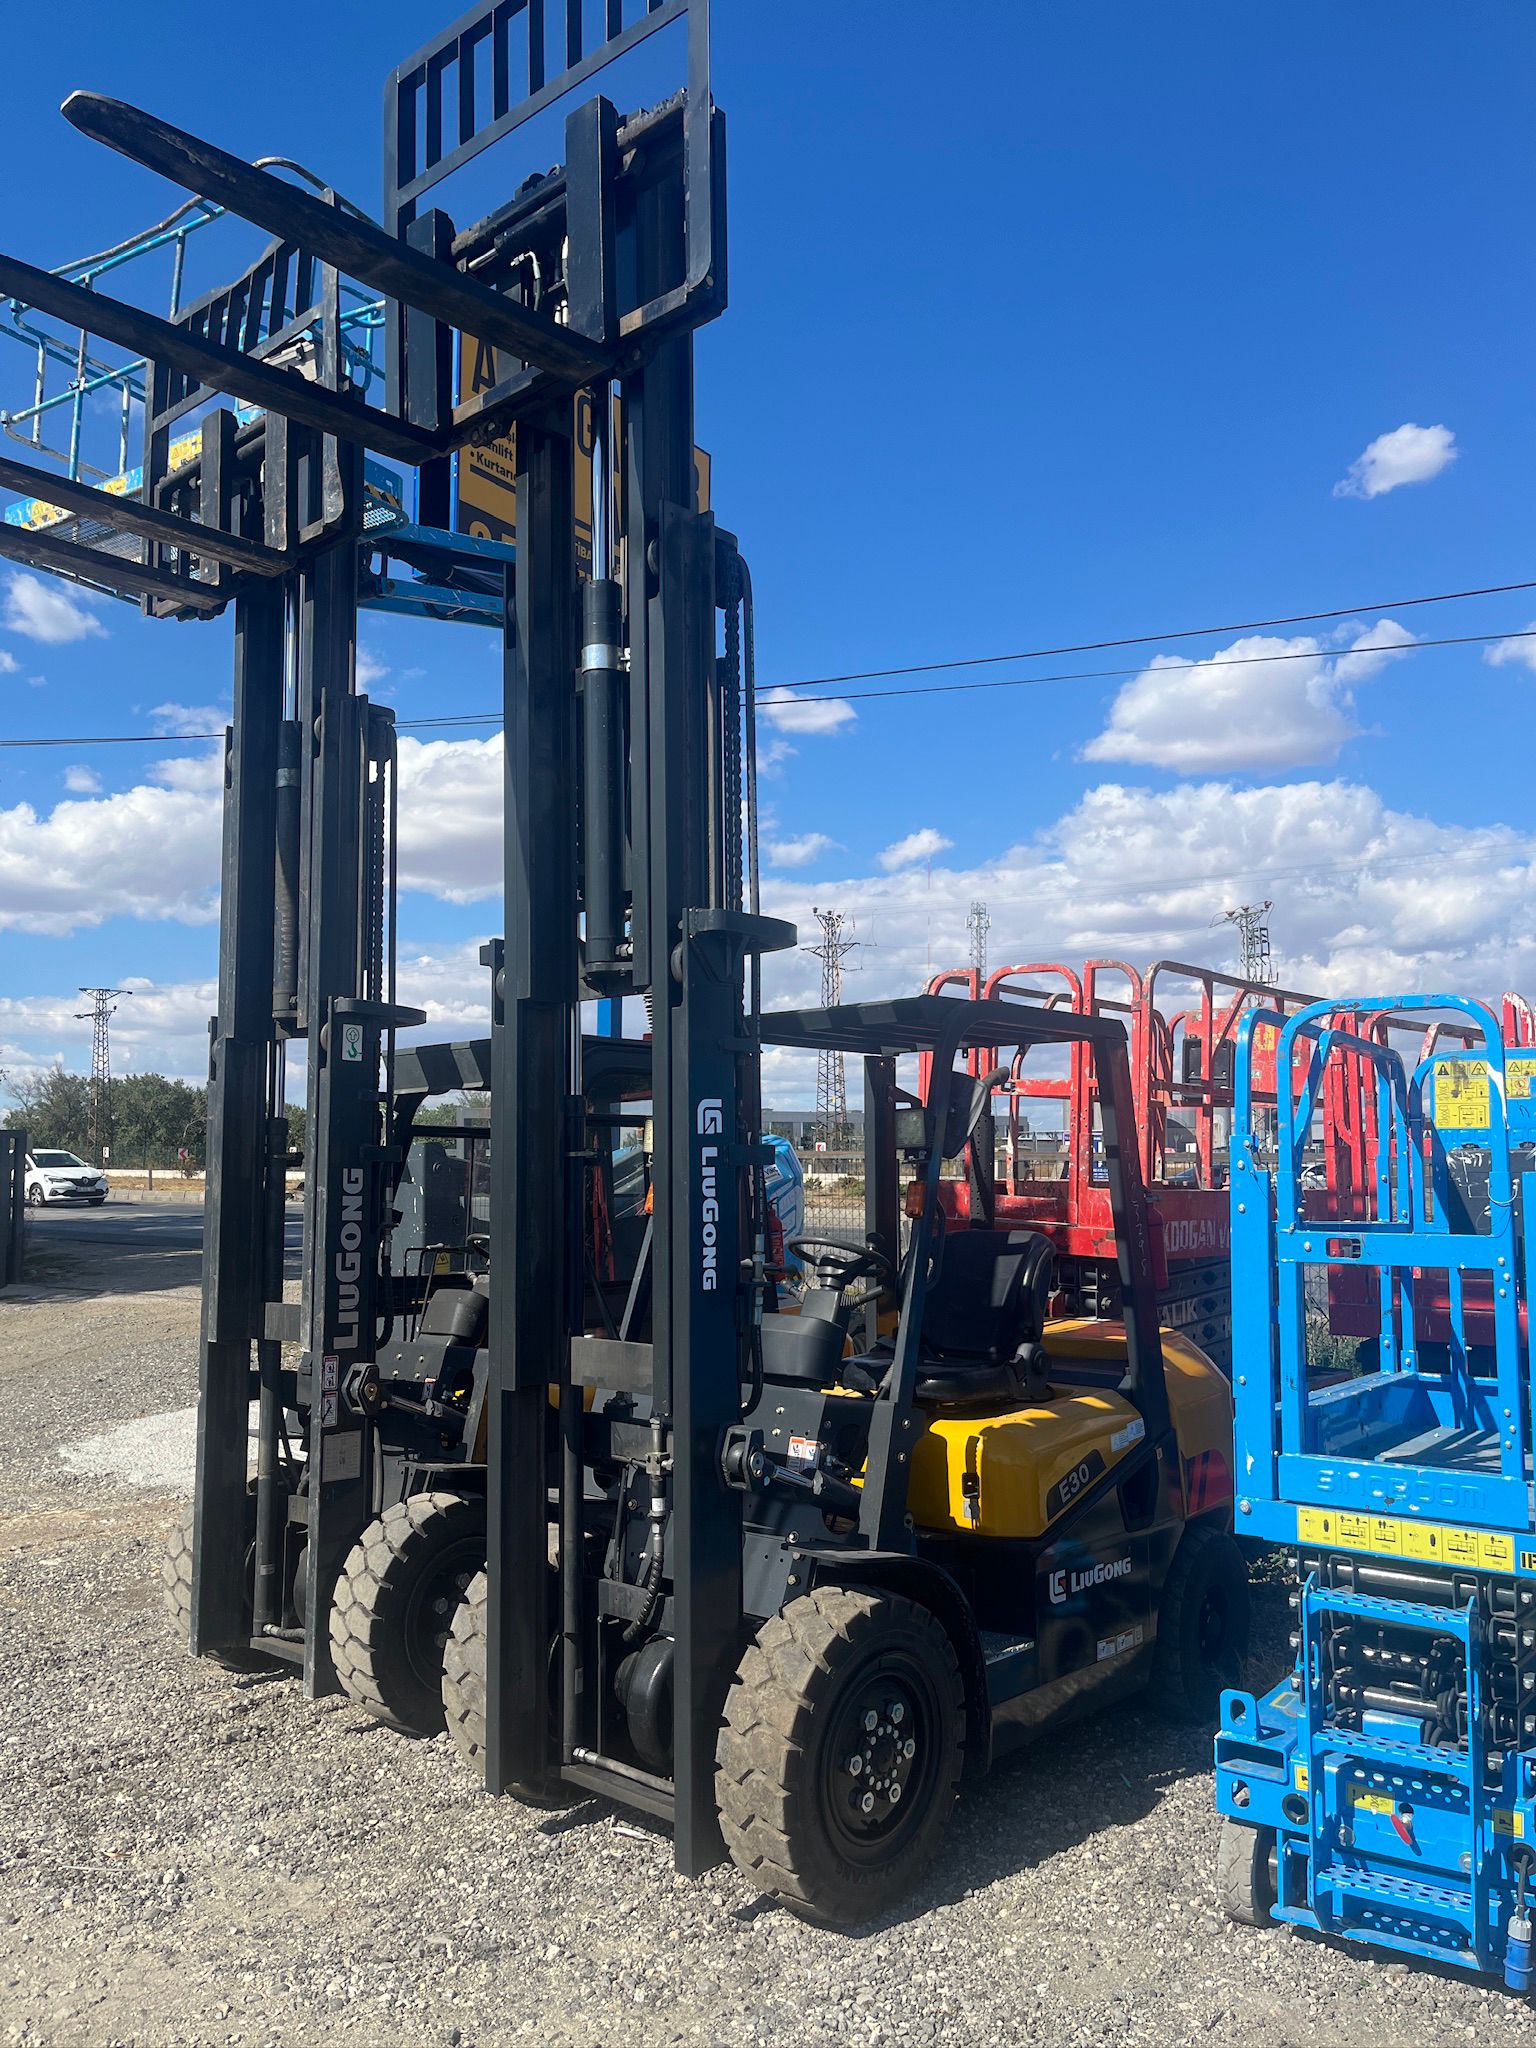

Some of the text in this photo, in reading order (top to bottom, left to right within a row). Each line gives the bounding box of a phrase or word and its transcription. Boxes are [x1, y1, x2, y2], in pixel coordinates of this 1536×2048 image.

[333, 1168, 364, 1350] LIUGONG
[702, 1147, 719, 1290] LIUGONG
[1157, 1297, 1198, 1328] ALIK
[1059, 1463, 1089, 1502] E30
